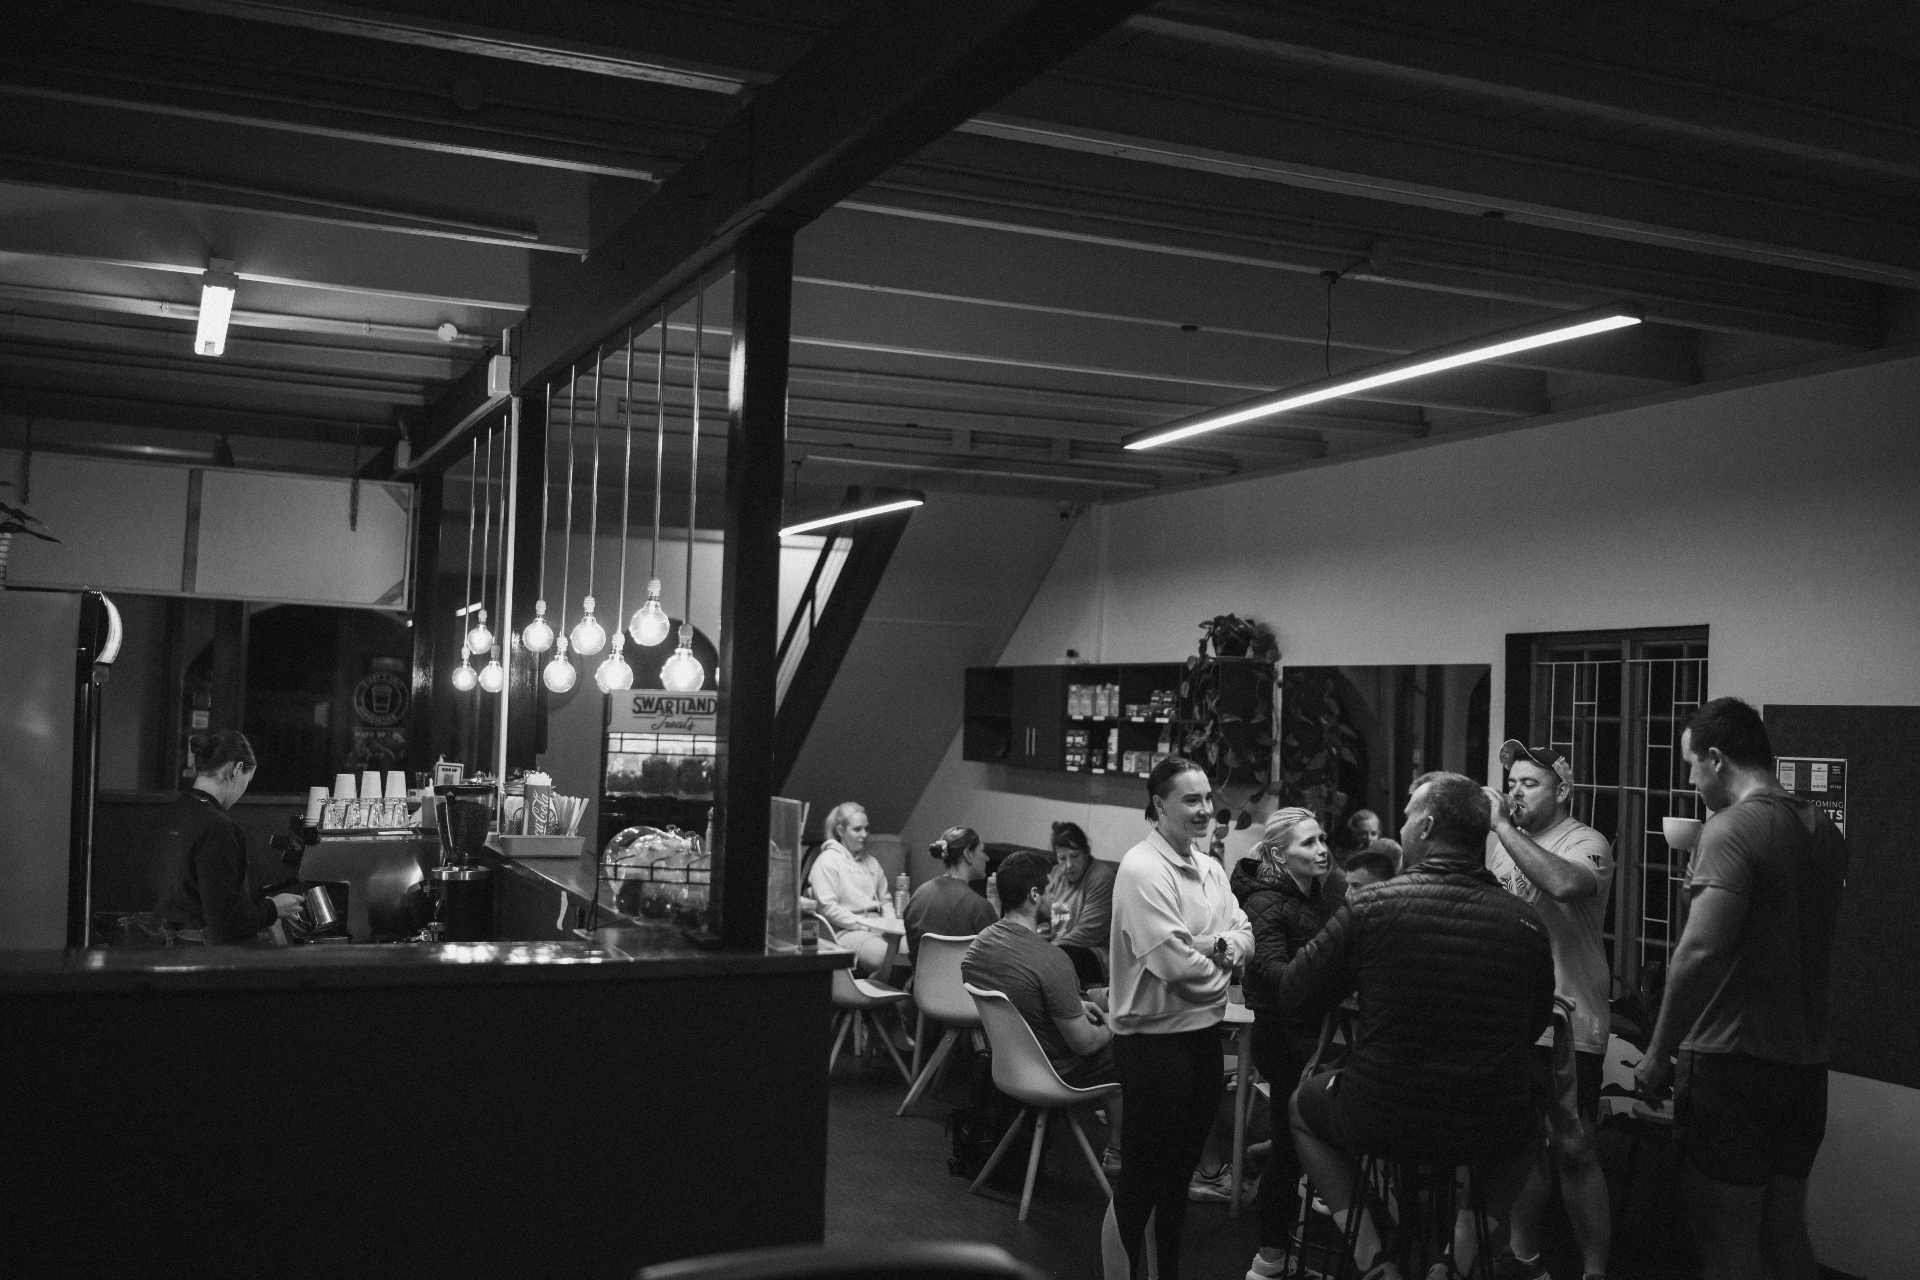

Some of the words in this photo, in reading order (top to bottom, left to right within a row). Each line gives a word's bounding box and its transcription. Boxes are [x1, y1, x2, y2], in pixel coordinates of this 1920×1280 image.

[632, 697, 718, 715] SWARTLAND
[651, 714, 695, 731] Treats
[1807, 799, 1843, 808] OMING
